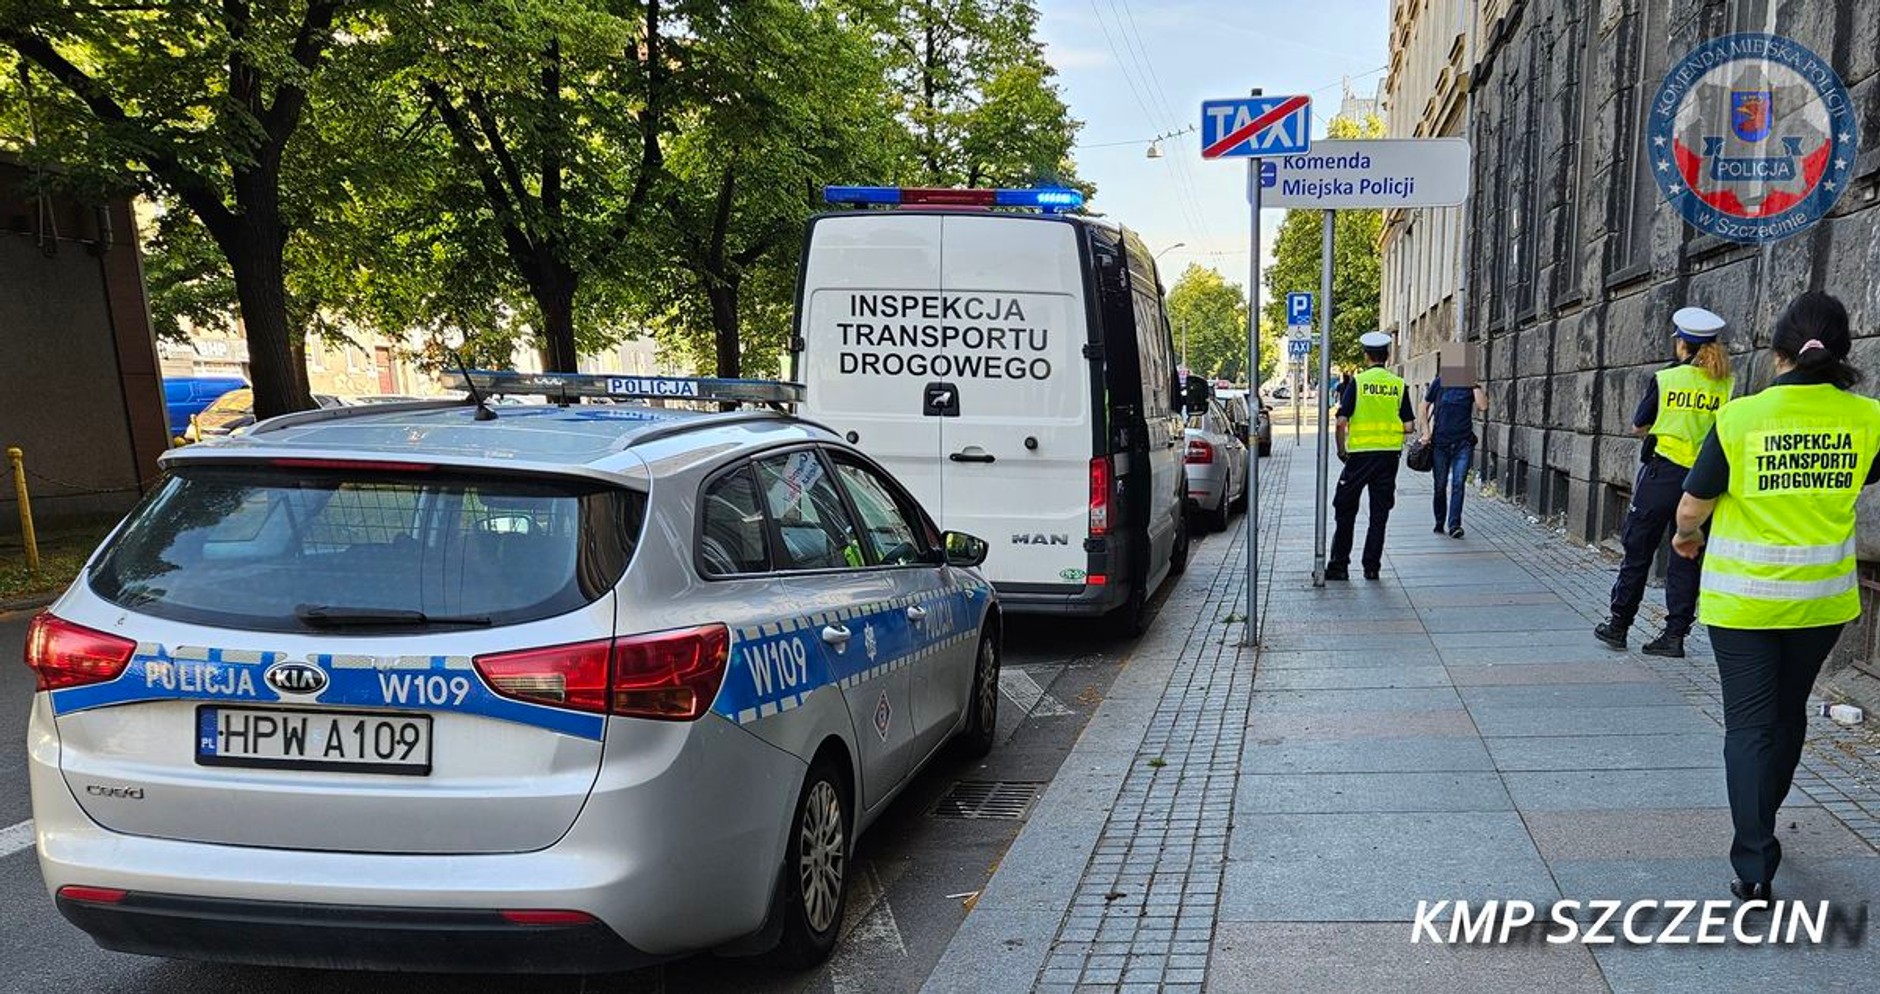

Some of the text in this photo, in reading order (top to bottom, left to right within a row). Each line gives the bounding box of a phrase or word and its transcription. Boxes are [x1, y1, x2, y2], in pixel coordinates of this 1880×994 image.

[1206, 103, 1305, 149] TAXI
[1283, 151, 1371, 170] Komenda
[1281, 177, 1415, 199] Miejska Policji
[850, 294, 1026, 321] INSPEKCJA
[1292, 296, 1308, 316] P
[837, 323, 1048, 351] TRANSPORTU
[199, 341, 227, 356] BHP
[1289, 341, 1310, 353] TAXI
[839, 352, 1052, 380] DROGOWEGO
[611, 379, 694, 395] POLICJA
[1363, 383, 1399, 397] POLICJA
[1666, 391, 1720, 412] POLICJA
[1764, 433, 1852, 452] INSPEKCJA
[1756, 453, 1858, 471] TRANSPORTU
[1758, 472, 1853, 491] DROGOWEGO
[1012, 534, 1068, 545] MAN
[742, 636, 808, 697] W109
[145, 661, 256, 697] POLICJA
[274, 669, 319, 688] KIA
[378, 672, 470, 706] W109
[201, 738, 216, 749] PL
[223, 714, 420, 761] HPW A109
